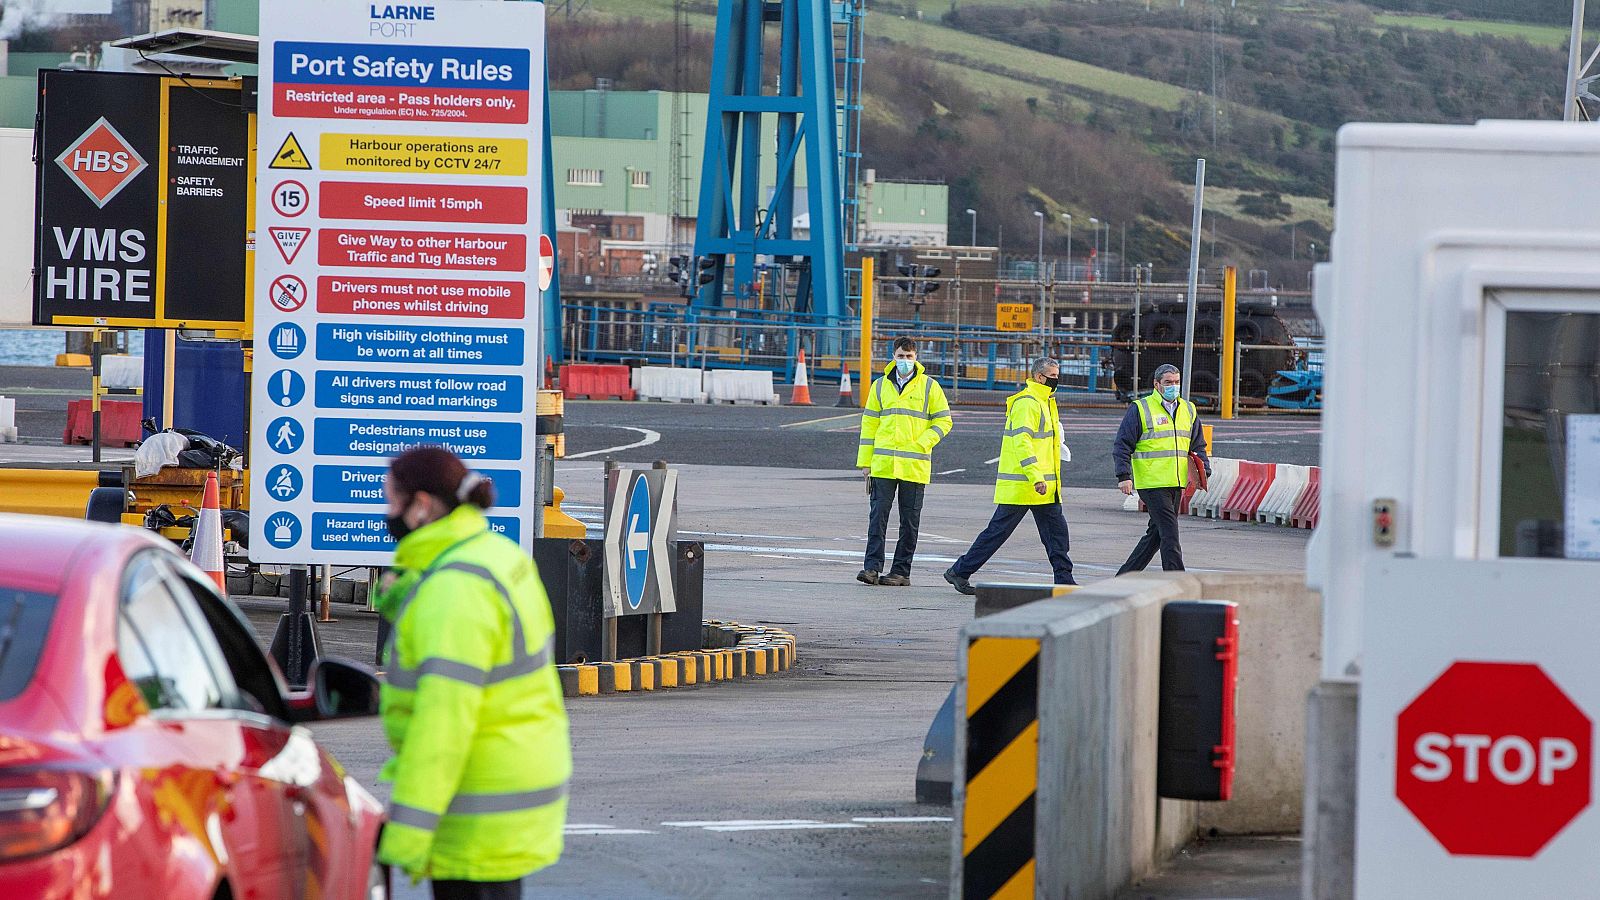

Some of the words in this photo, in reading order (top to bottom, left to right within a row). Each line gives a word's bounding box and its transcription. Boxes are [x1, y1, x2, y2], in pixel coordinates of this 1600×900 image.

[371, 5, 435, 20] LARNE
[370, 22, 416, 37] PORT
[291, 54, 345, 76] Port
[353, 56, 433, 83] Safety
[441, 59, 513, 81] Rules
[286, 90, 354, 104] Restricted
[357, 94, 386, 104] area
[398, 94, 431, 105] Pass
[433, 95, 482, 107] holders
[486, 97, 515, 109] only.
[334, 106, 357, 114] Under
[359, 108, 396, 116] regulation
[398, 108, 414, 116] (EC)
[431, 109, 467, 117] 725/2004.
[178, 145, 219, 154] TRAFFIC
[350, 139, 402, 151] Harbour
[406, 141, 473, 155] operations
[478, 144, 498, 153] are
[73, 150, 129, 173] HBS
[177, 156, 244, 166] MANAGEMENT
[346, 156, 412, 168] monitored
[415, 157, 430, 169] by
[434, 157, 470, 169] CCTV
[474, 158, 500, 170] 24/7
[177, 177, 214, 185] SAFETY
[177, 188, 223, 197] BARRIERS
[280, 190, 300, 206] 15
[364, 195, 405, 208] Speed
[408, 196, 436, 208] limit
[439, 198, 483, 210] 15mph
[277, 232, 300, 240] GIVE
[338, 234, 367, 246] Give
[370, 235, 397, 249] Way
[400, 237, 413, 247] to
[417, 237, 452, 248] other
[454, 238, 507, 250] Harbour
[53, 226, 146, 263] VMS
[347, 250, 388, 262] Traffic
[390, 252, 415, 263] and
[418, 252, 442, 266] Tug
[445, 253, 497, 266] Masters
[46, 266, 150, 302] HIRE
[331, 281, 378, 294] Drivers
[381, 284, 413, 294] must
[417, 285, 439, 295] not
[442, 288, 465, 296] use
[467, 286, 511, 297] mobile
[353, 299, 400, 312] phones
[404, 300, 442, 311] whilst
[445, 300, 489, 314] driving
[332, 328, 362, 341] High
[365, 329, 417, 342] visibility
[421, 331, 472, 344] clothing
[475, 333, 508, 344] must
[357, 346, 372, 356] be
[375, 349, 409, 357] worn
[412, 348, 426, 357] at
[429, 347, 444, 358] all
[447, 348, 483, 359] times
[331, 376, 349, 387] All
[352, 376, 396, 388] drivers
[399, 379, 432, 390] must
[435, 378, 474, 390] follow
[477, 380, 506, 391] road
[340, 393, 374, 406] signs
[377, 393, 402, 404] and
[405, 394, 435, 405] road
[438, 395, 498, 408] markings
[350, 424, 425, 436] Pedestrians
[428, 427, 461, 437] must
[464, 429, 487, 438] use
[349, 440, 421, 453] designated
[342, 471, 387, 482] Drivers
[350, 488, 384, 499] must
[327, 519, 365, 529] Hazard
[367, 519, 391, 531] ligh
[492, 523, 505, 533] be
[323, 532, 348, 542] used
[351, 532, 380, 543] when
[1410, 732, 1578, 786] STOP
